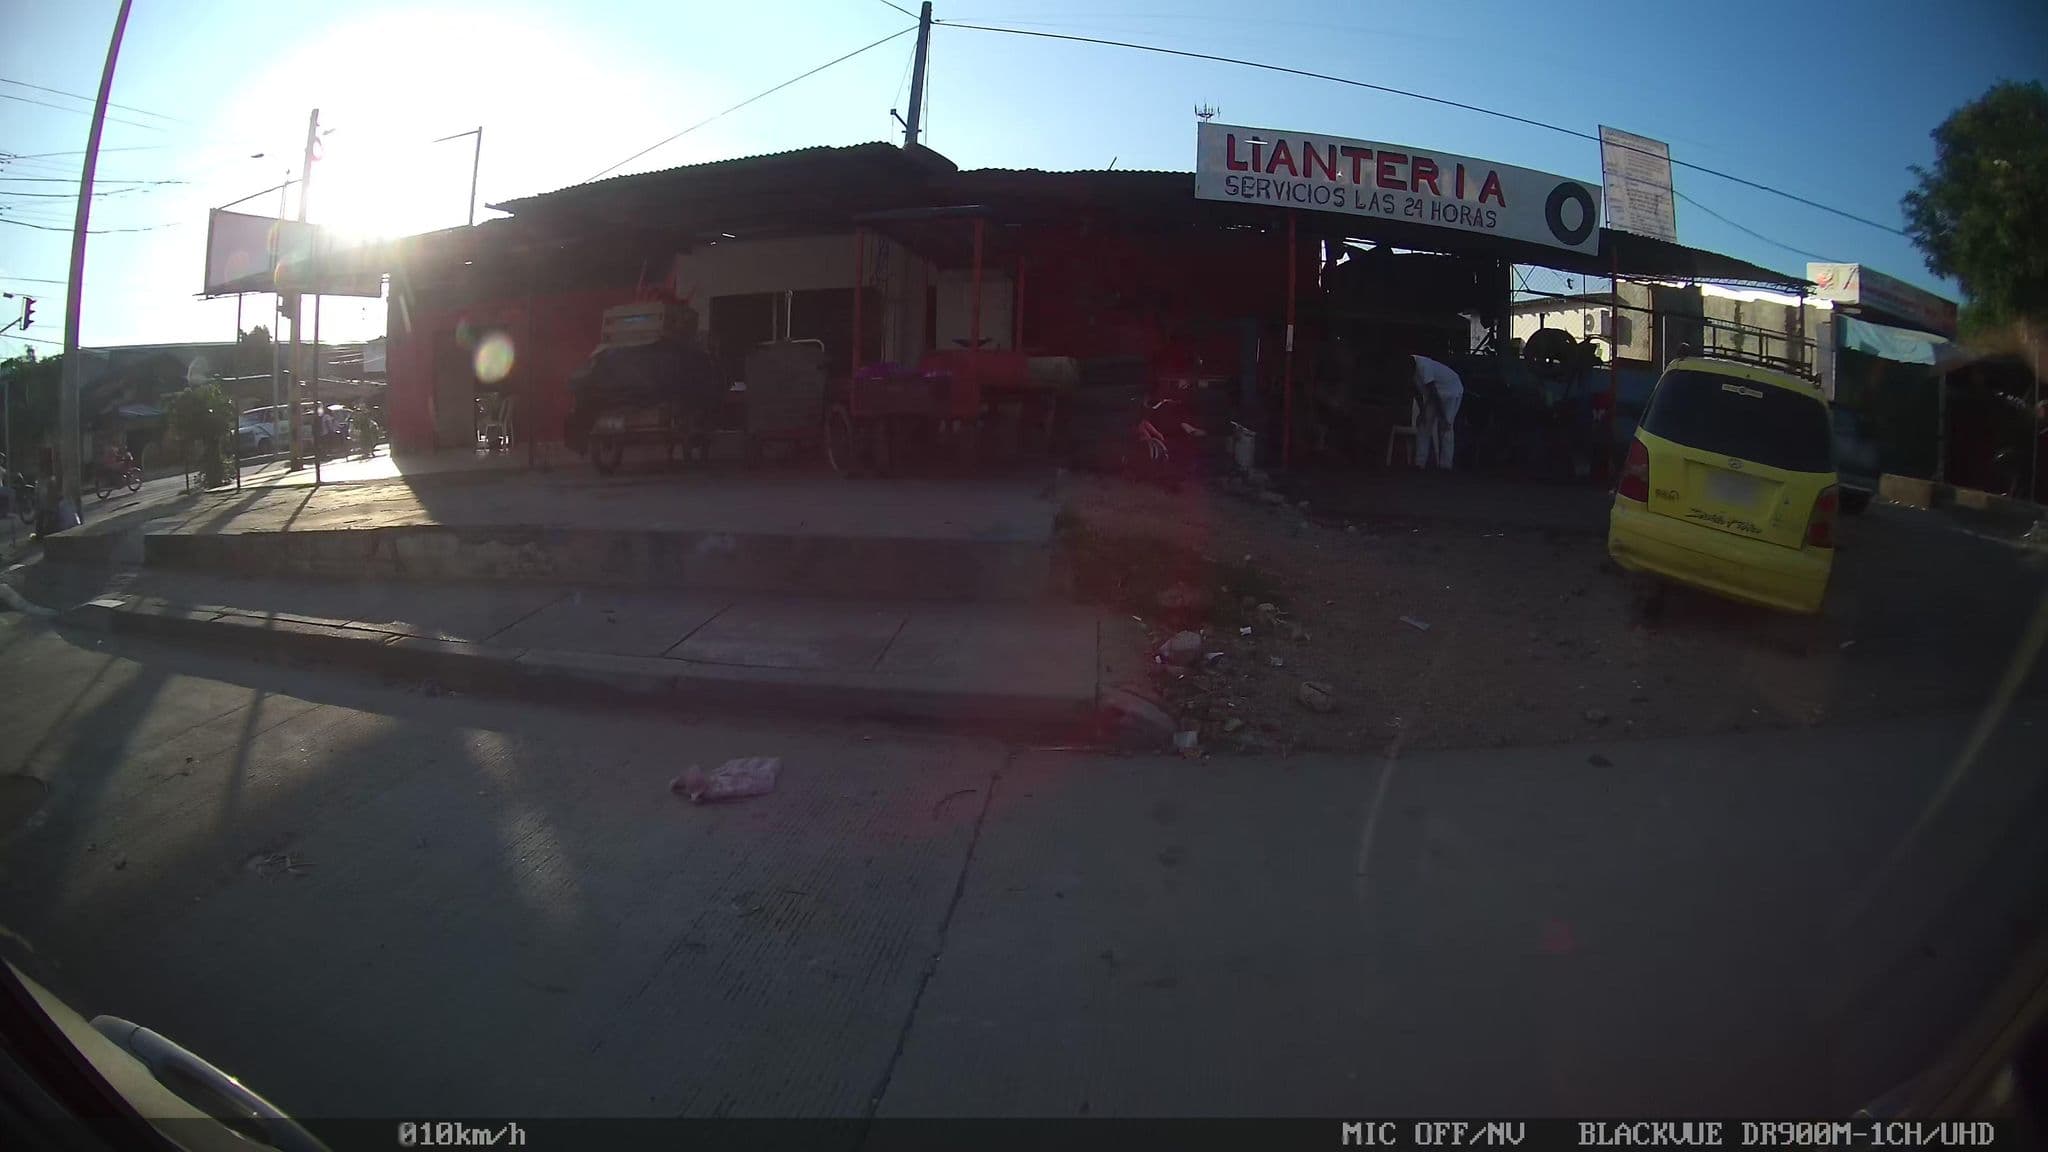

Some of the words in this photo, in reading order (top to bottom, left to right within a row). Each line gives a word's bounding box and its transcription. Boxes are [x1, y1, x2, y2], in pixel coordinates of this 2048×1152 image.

[1224, 175, 1345, 207] SERVICIOS
[1356, 189, 1395, 214] LAS
[1403, 197, 1423, 219] 24
[1430, 200, 1497, 229] HORAS
